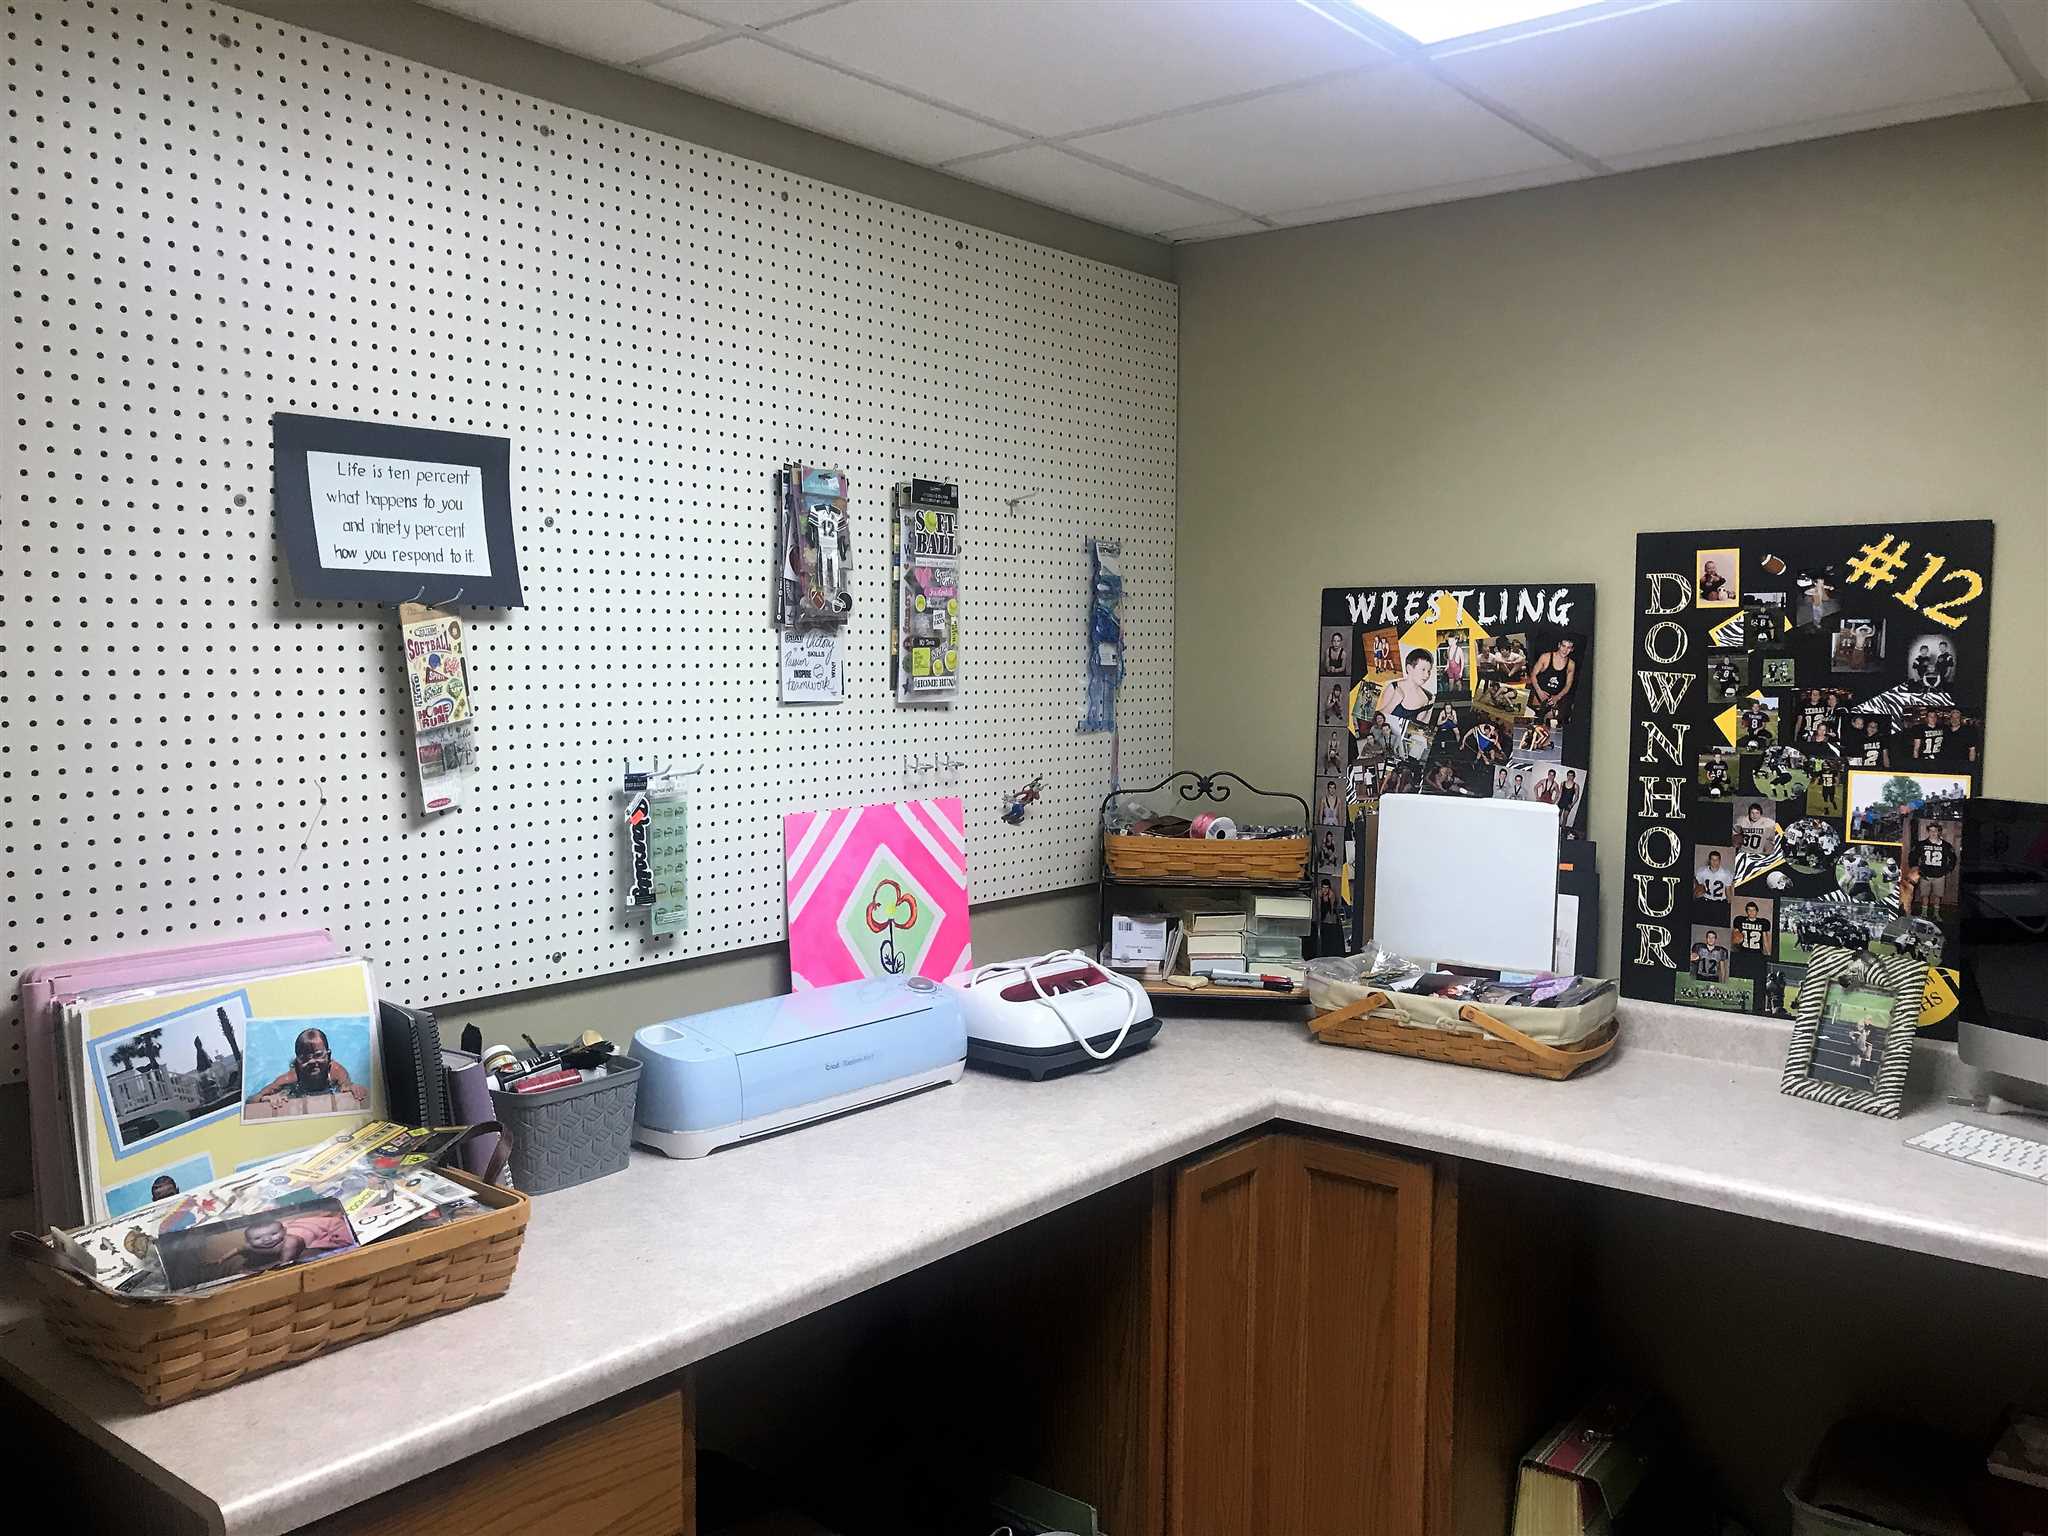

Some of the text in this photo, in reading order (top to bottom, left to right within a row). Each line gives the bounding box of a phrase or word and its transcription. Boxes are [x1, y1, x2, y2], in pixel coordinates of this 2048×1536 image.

[338, 461, 470, 486] Life is ten percent
[326, 489, 463, 514] what happens to you
[342, 517, 465, 540] and ninety percent
[821, 520, 835, 538] 12
[914, 532, 957, 556] BALL
[334, 544, 357, 559] how
[364, 549, 387, 564] you
[393, 545, 444, 566] respond
[450, 547, 462, 563] to
[1845, 533, 1984, 630] #12
[1346, 587, 1575, 626] WRESTLING
[406, 630, 452, 661] SOFTBALL
[793, 670, 811, 678] INSPIRE
[786, 676, 833, 691] teamwork
[917, 679, 954, 688] HOME RUN
[418, 703, 450, 720] HOME
[422, 714, 450, 728] RUN!
[1752, 719, 1758, 729] 8
[1805, 714, 1825, 730] 12
[1923, 737, 1944, 753] 12
[1633, 572, 1697, 969] DOWNHOUR
[1924, 850, 1943, 866] 12
[1704, 879, 1724, 897] 12
[1742, 930, 1761, 949] 12
[1701, 958, 1717, 974] 12
[1918, 991, 1944, 1013] HS
